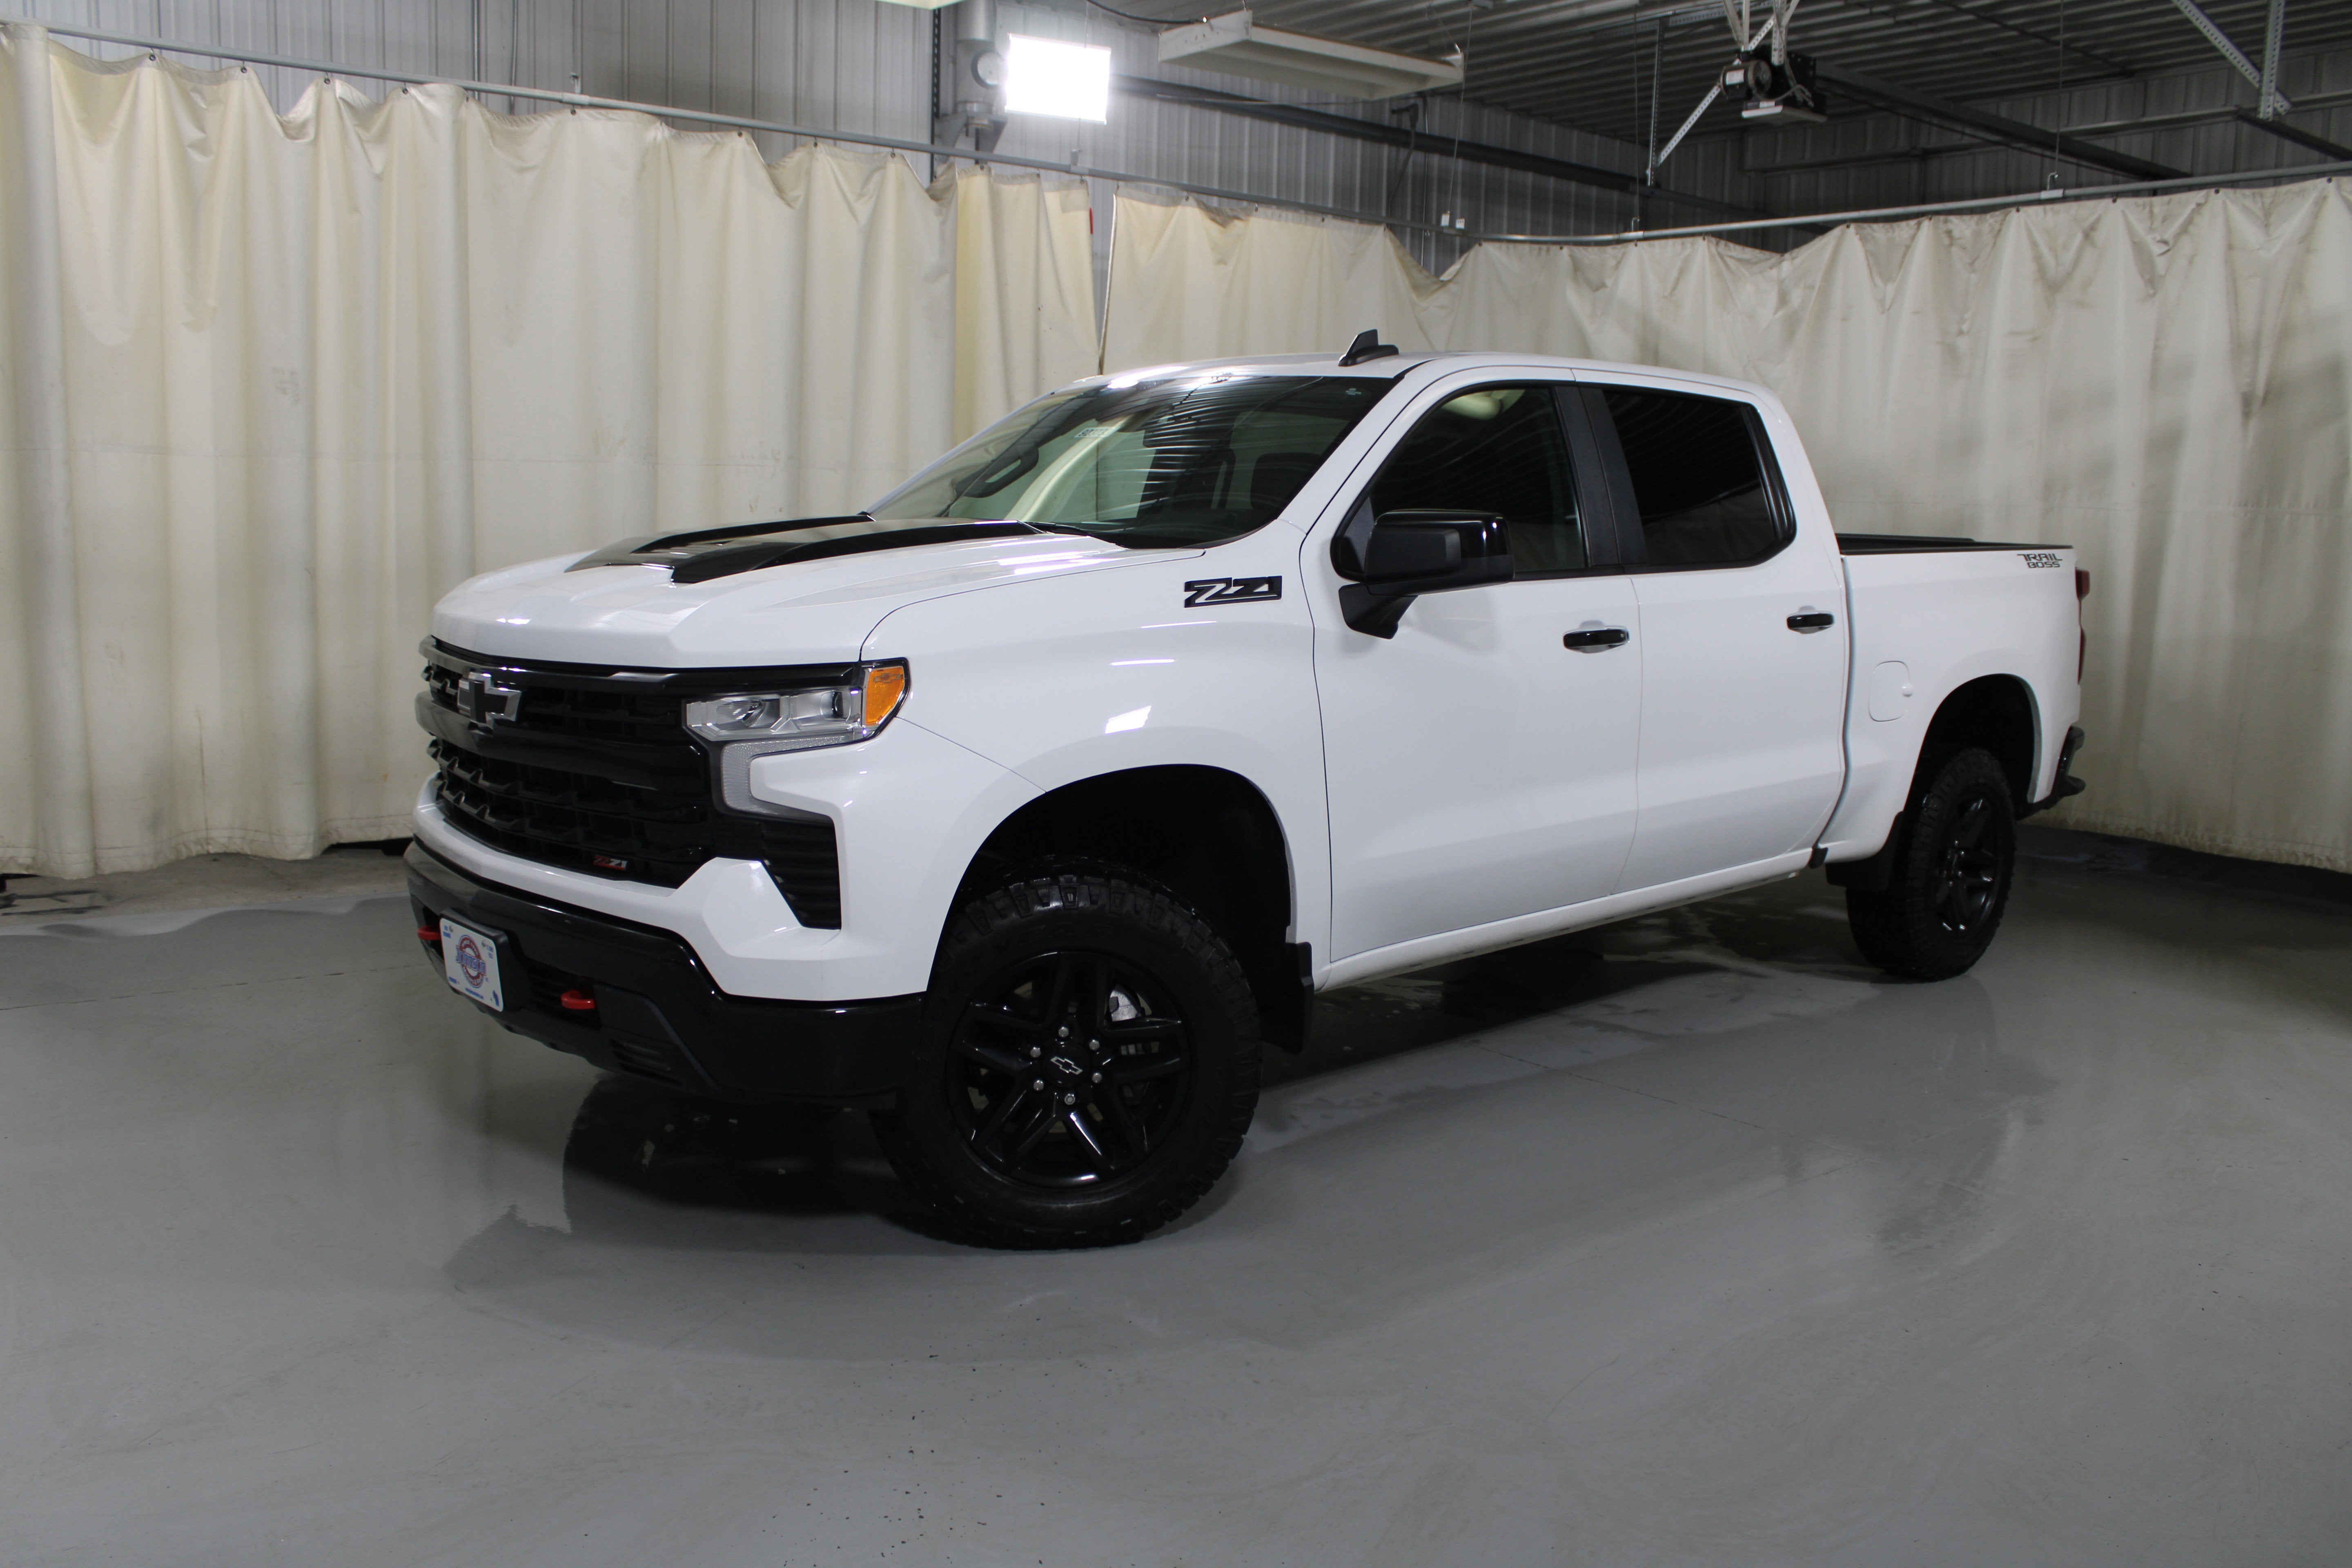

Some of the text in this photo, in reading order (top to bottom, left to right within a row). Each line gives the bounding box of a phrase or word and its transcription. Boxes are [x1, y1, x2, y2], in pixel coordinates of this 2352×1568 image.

[2017, 553, 2063, 561] TRAIL
[1184, 575, 1282, 608] Z71
[593, 855, 627, 871] Z71
